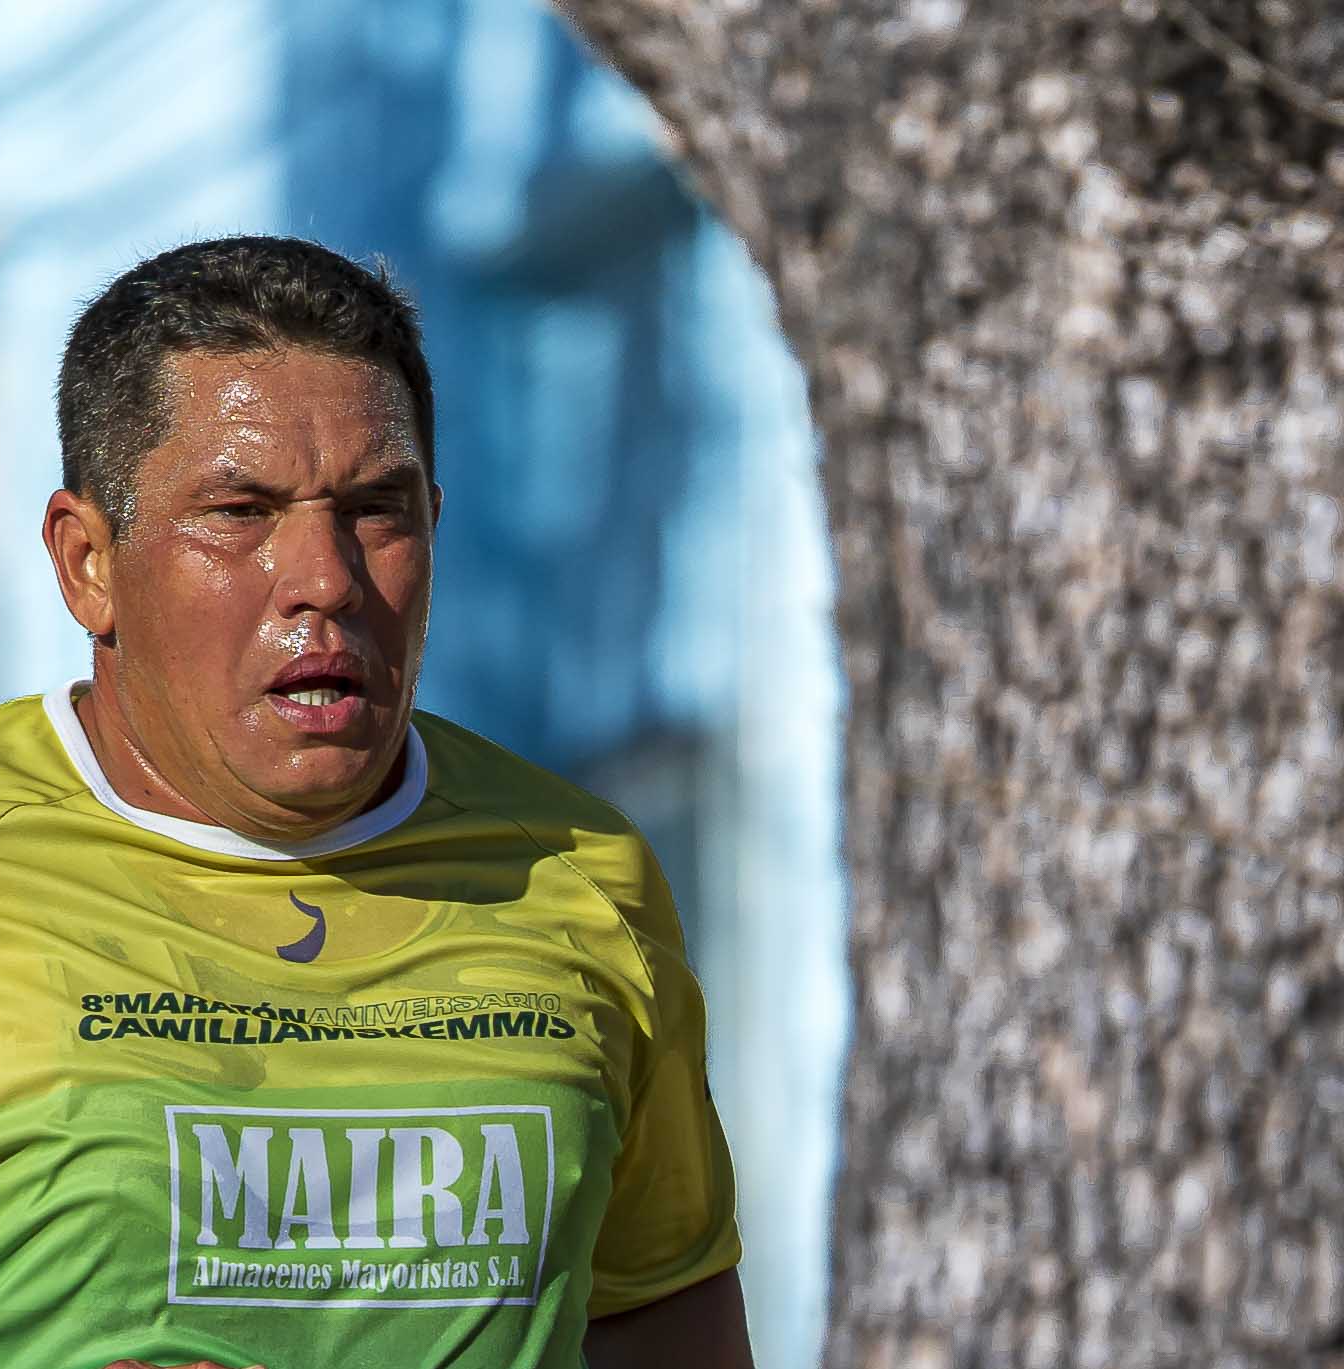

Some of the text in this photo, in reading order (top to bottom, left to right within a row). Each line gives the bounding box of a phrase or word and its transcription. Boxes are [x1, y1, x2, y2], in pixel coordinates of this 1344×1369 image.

[192, 1123, 530, 1249] MAIRA
[192, 1256, 525, 1294] Almacenes Mayoristas S.A.
